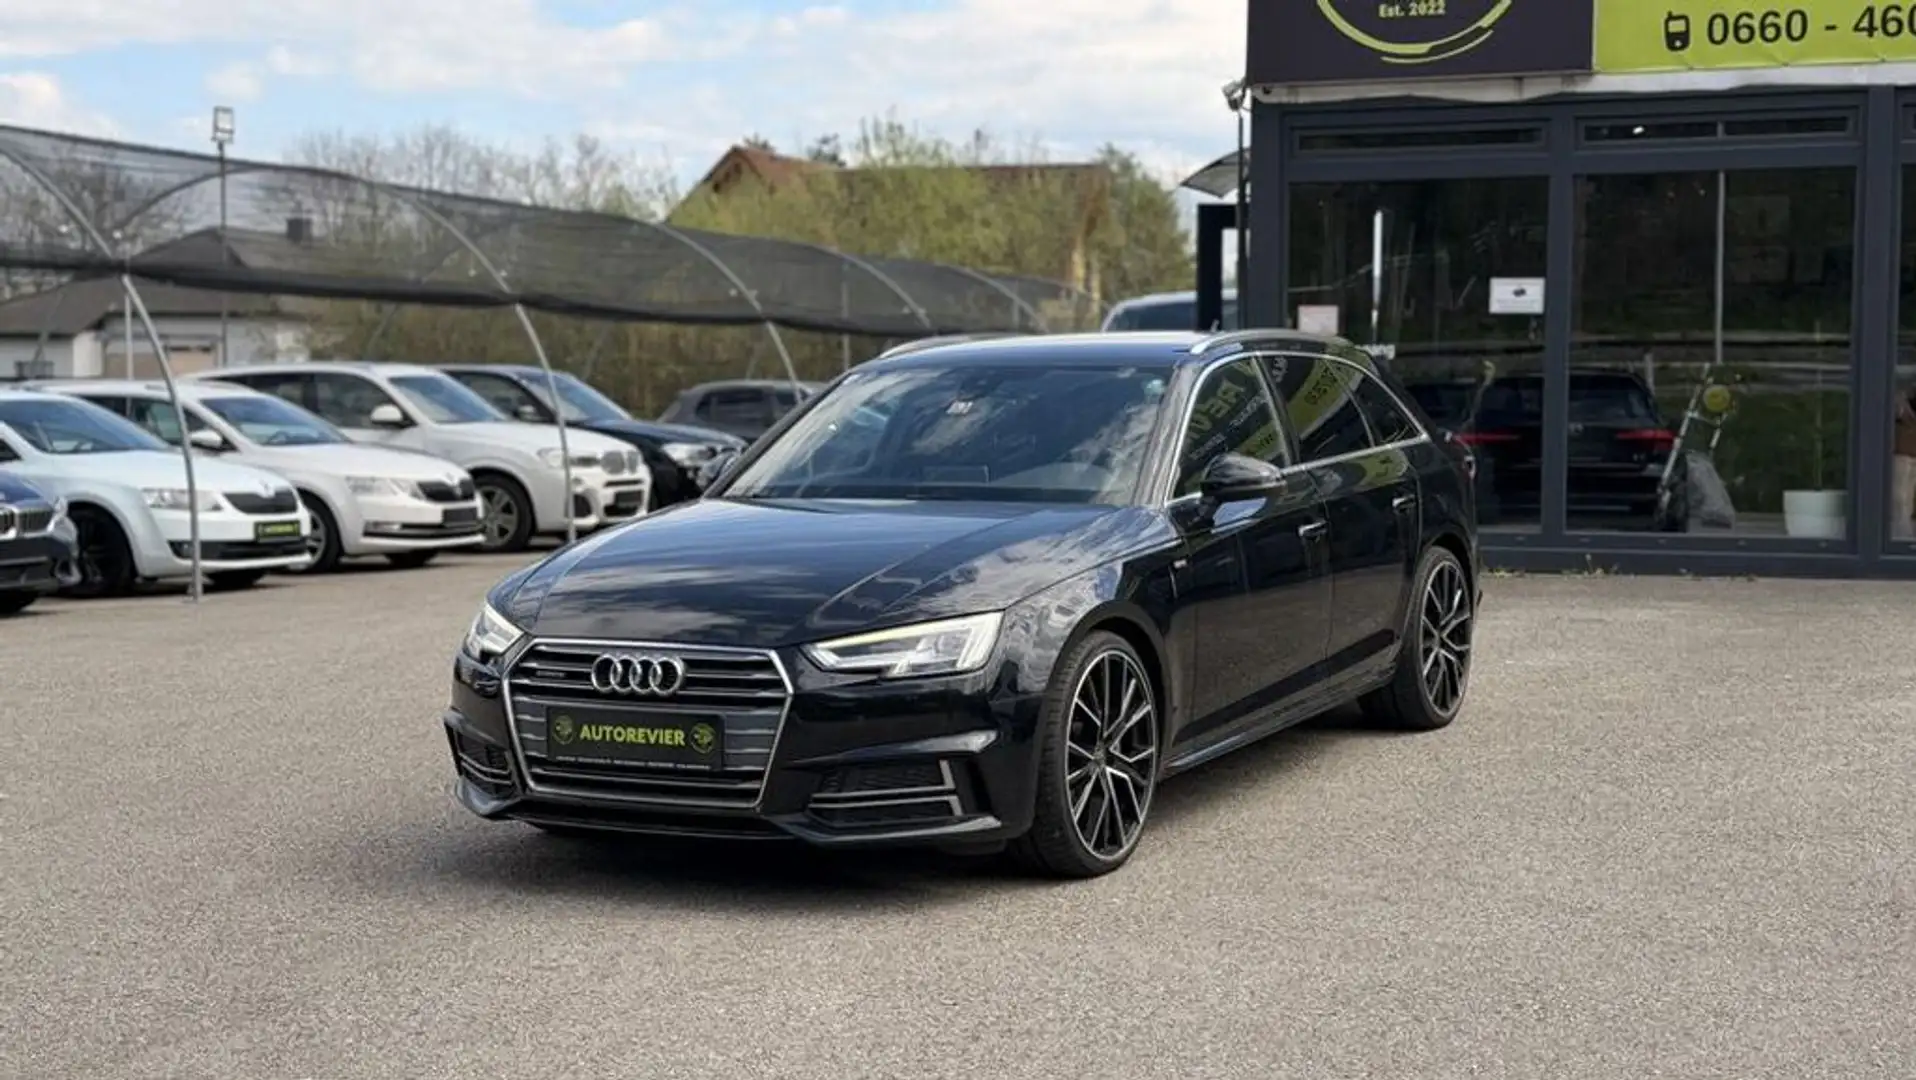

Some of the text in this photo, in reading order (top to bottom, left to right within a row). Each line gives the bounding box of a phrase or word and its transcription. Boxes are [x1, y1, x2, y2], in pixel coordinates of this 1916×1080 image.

[1378, 1, 1446, 18] Est. 2022
[1707, 9, 1808, 46] 0660
[579, 723, 686, 747] AUTOREVIER
